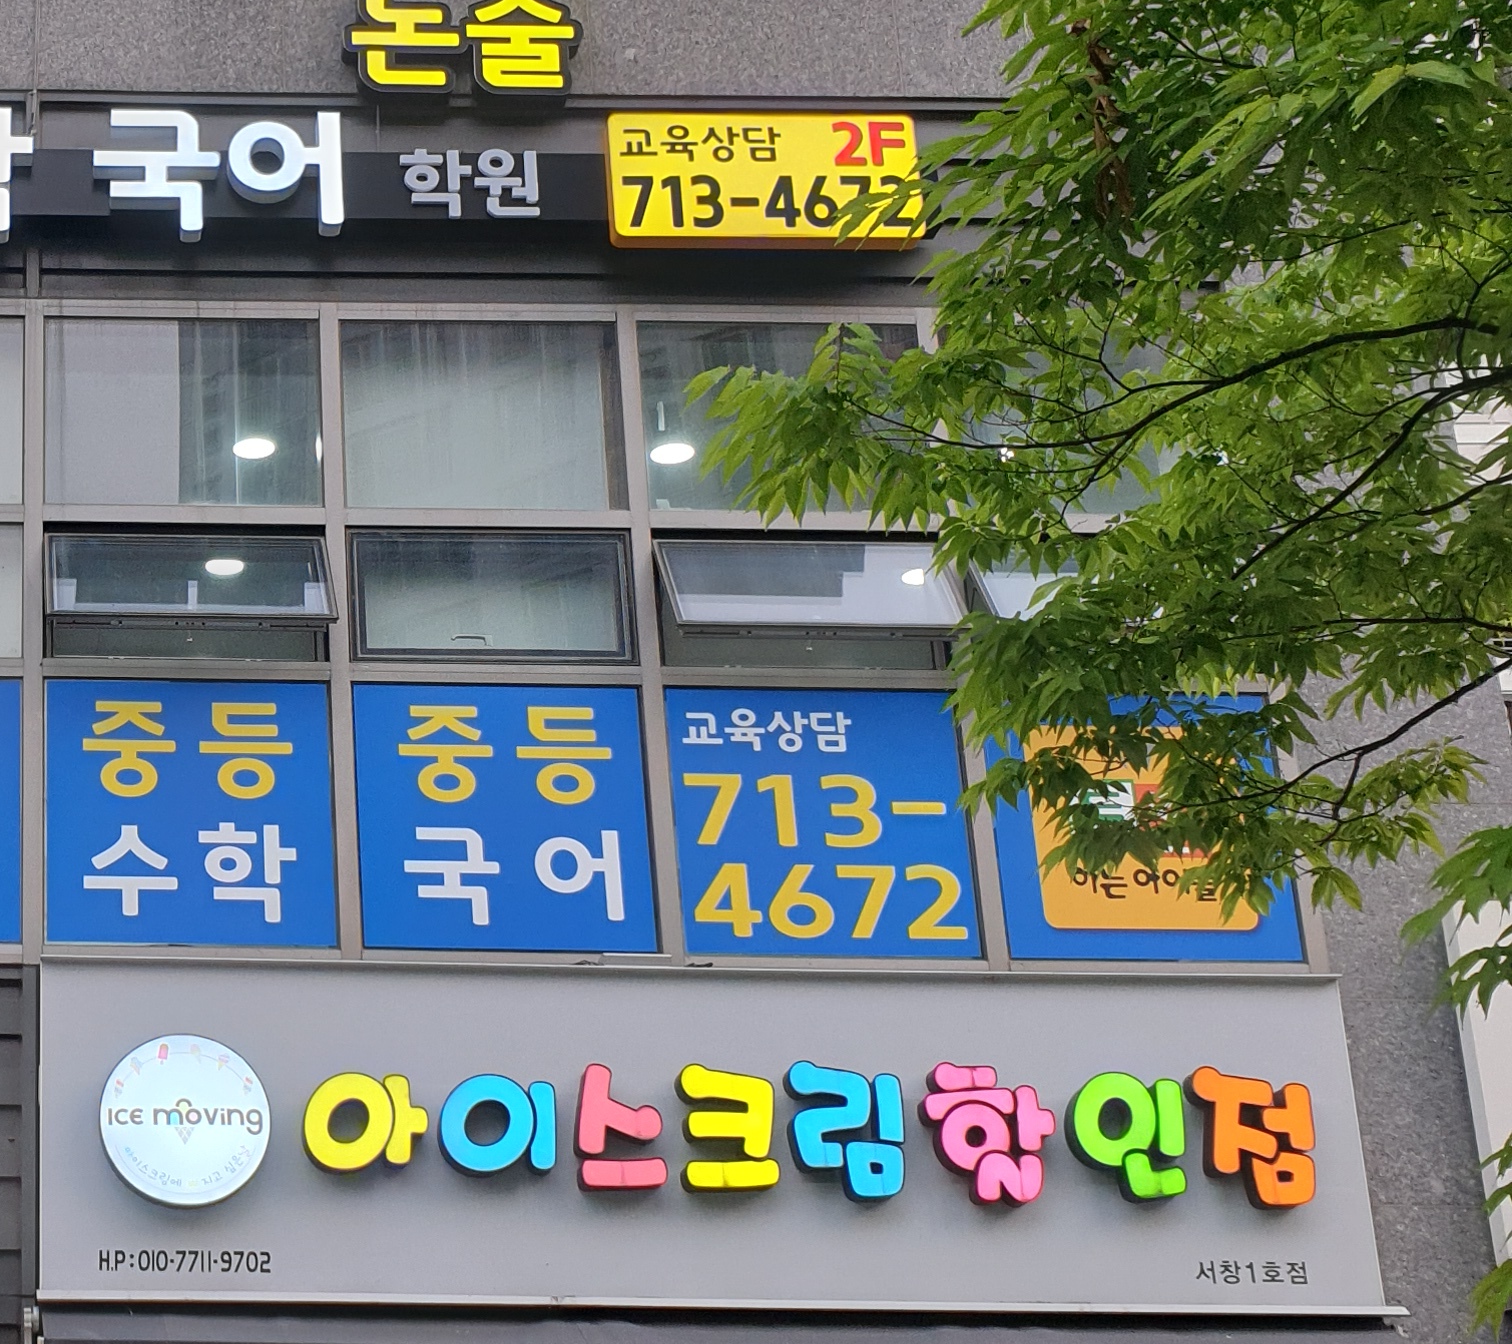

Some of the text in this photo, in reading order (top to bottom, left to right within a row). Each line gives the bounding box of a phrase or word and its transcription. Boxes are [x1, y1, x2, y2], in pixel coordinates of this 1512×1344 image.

[93, 109, 345, 242] 국어
[399, 147, 541, 220] 학원
[619, 121, 907, 167] 교육상담 2F
[82, 700, 294, 800] 중등
[398, 705, 612, 805] 중등
[682, 707, 852, 754] 교육상담
[682, 773, 947, 849] 713-
[83, 822, 297, 924] 수학
[403, 826, 625, 927] 국어
[694, 863, 969, 940] 4672
[106, 1107, 144, 1126] ICE
[1195, 1259, 1309, 1286] 서창1호점
